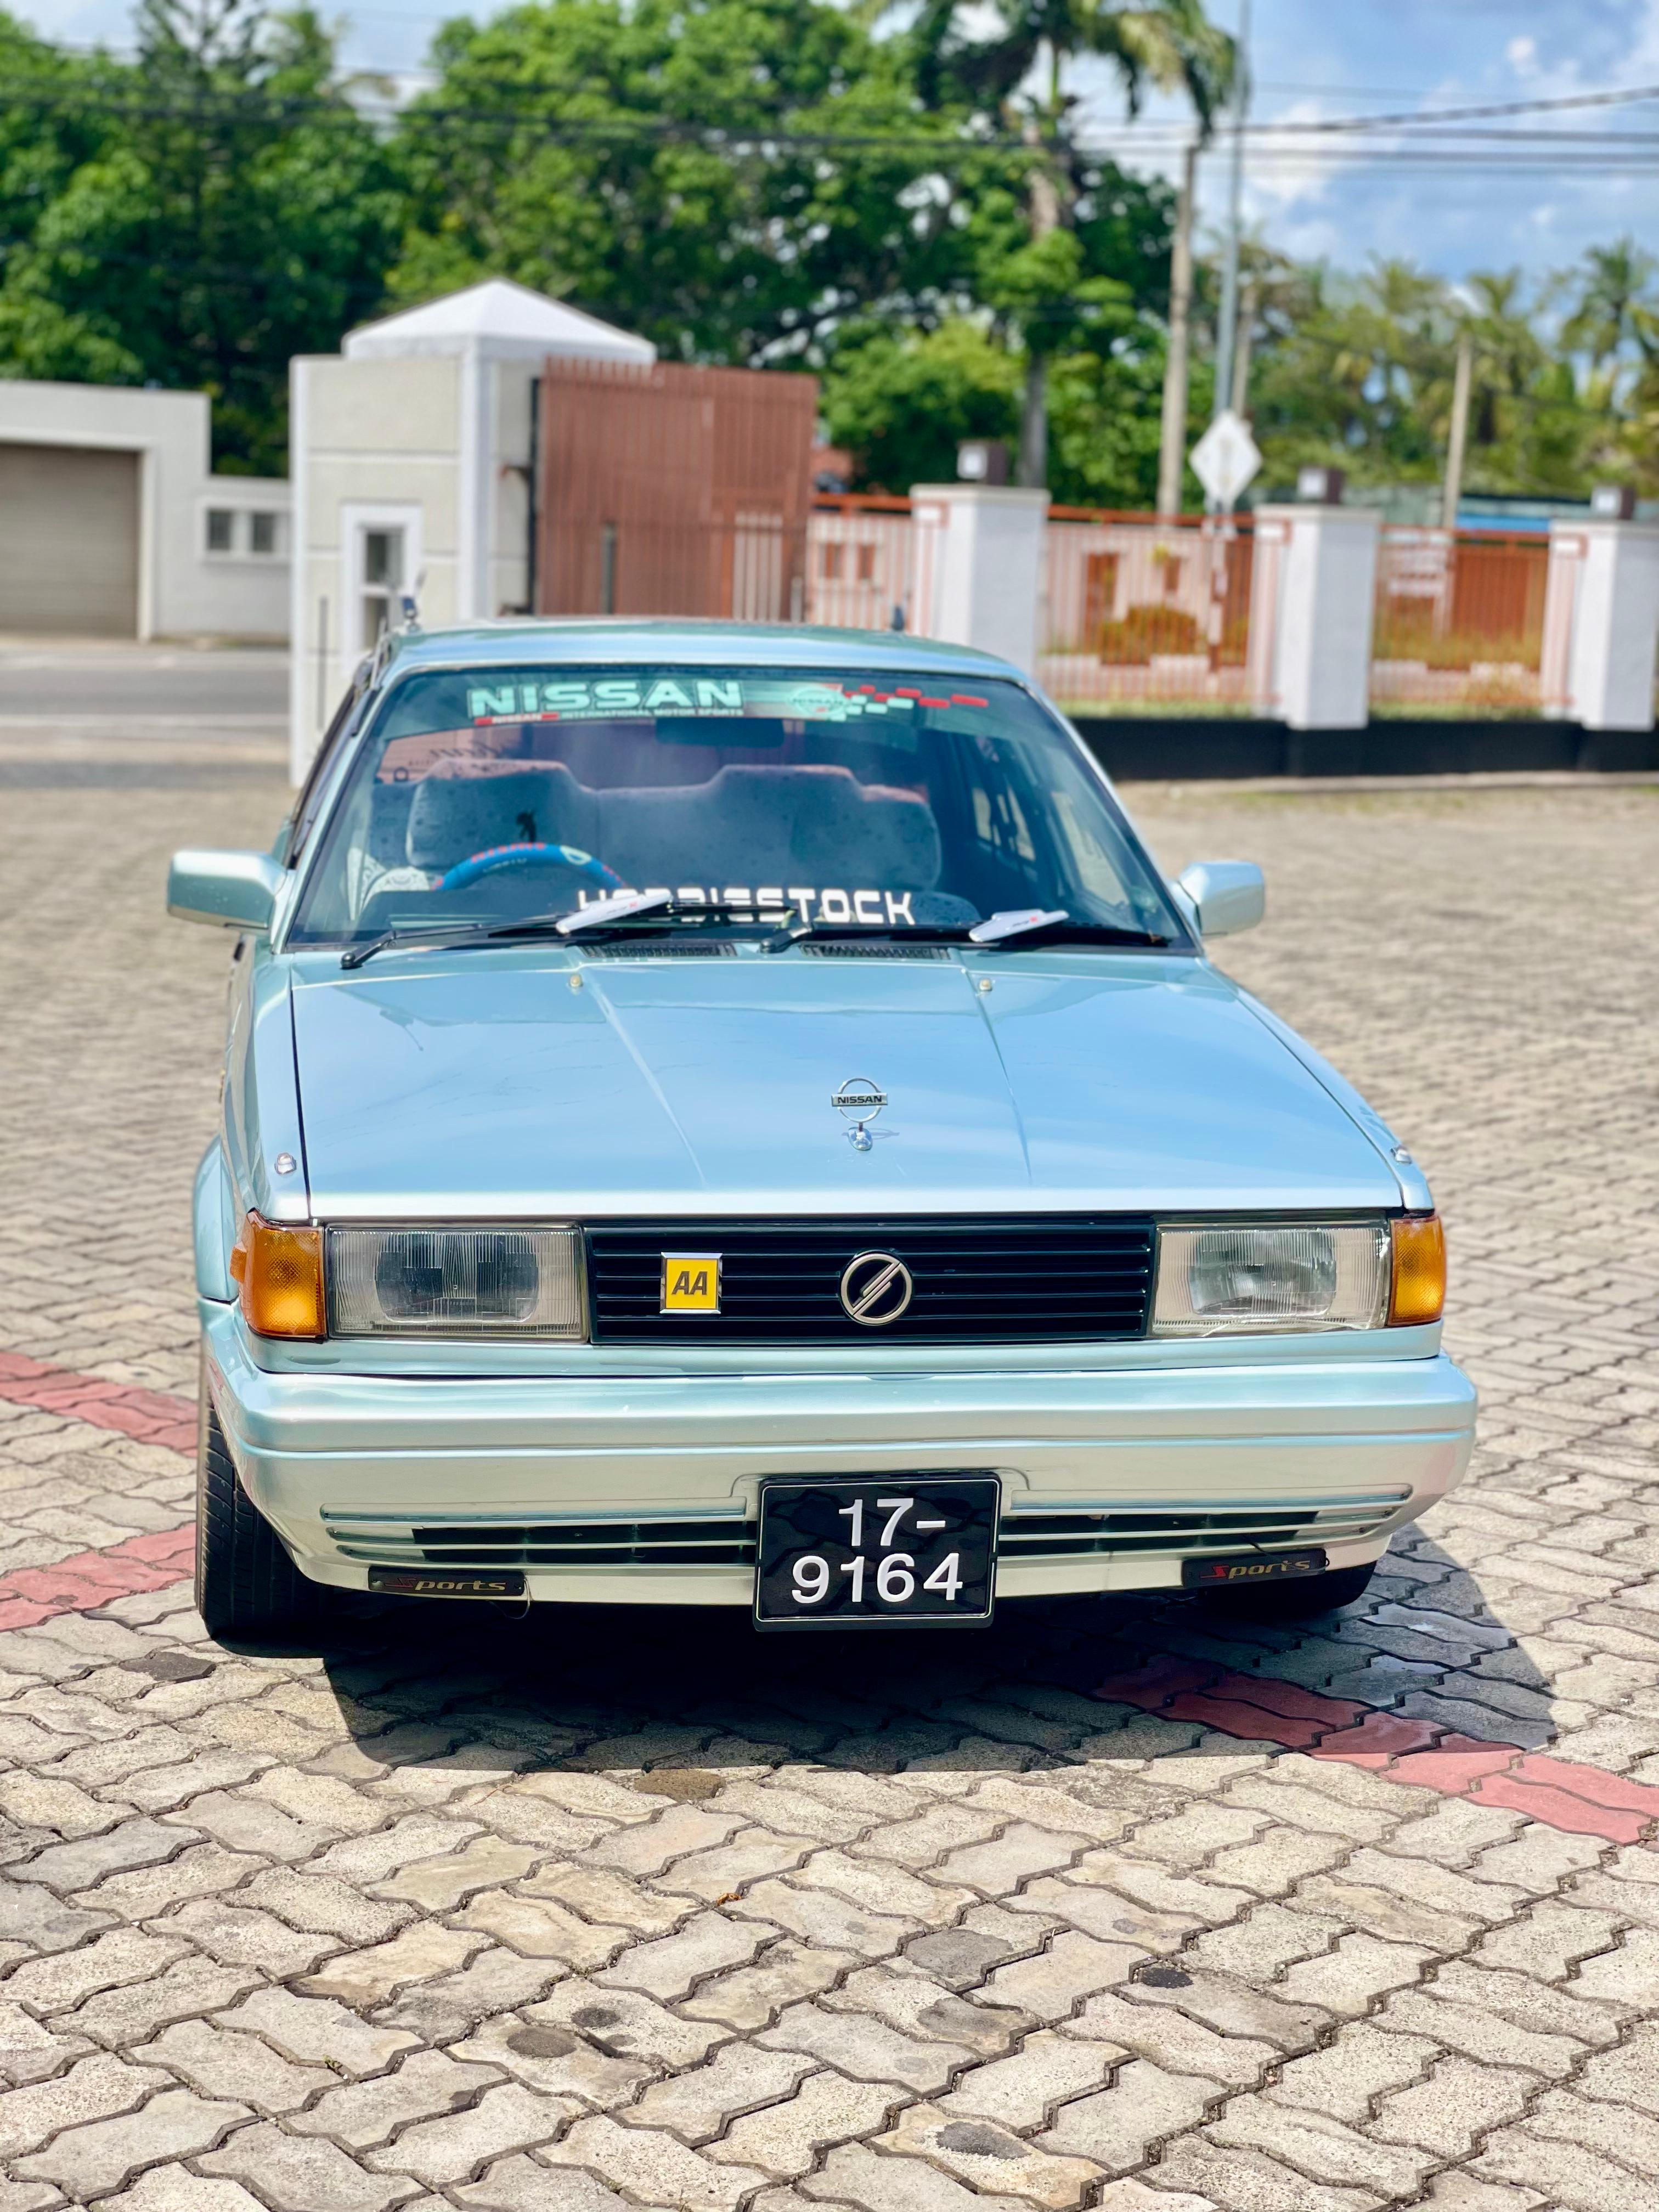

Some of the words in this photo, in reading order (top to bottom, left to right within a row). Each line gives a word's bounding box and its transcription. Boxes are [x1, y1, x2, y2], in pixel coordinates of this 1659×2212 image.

[470, 680, 743, 716] NISSAN
[838, 1095, 882, 1104] NISSAN
[672, 1271, 708, 1295] AA
[839, 1498, 945, 1547] 17-
[792, 1553, 963, 1604] 9164
[1200, 1560, 1311, 1579] Sports
[385, 1577, 506, 1590] Sports
